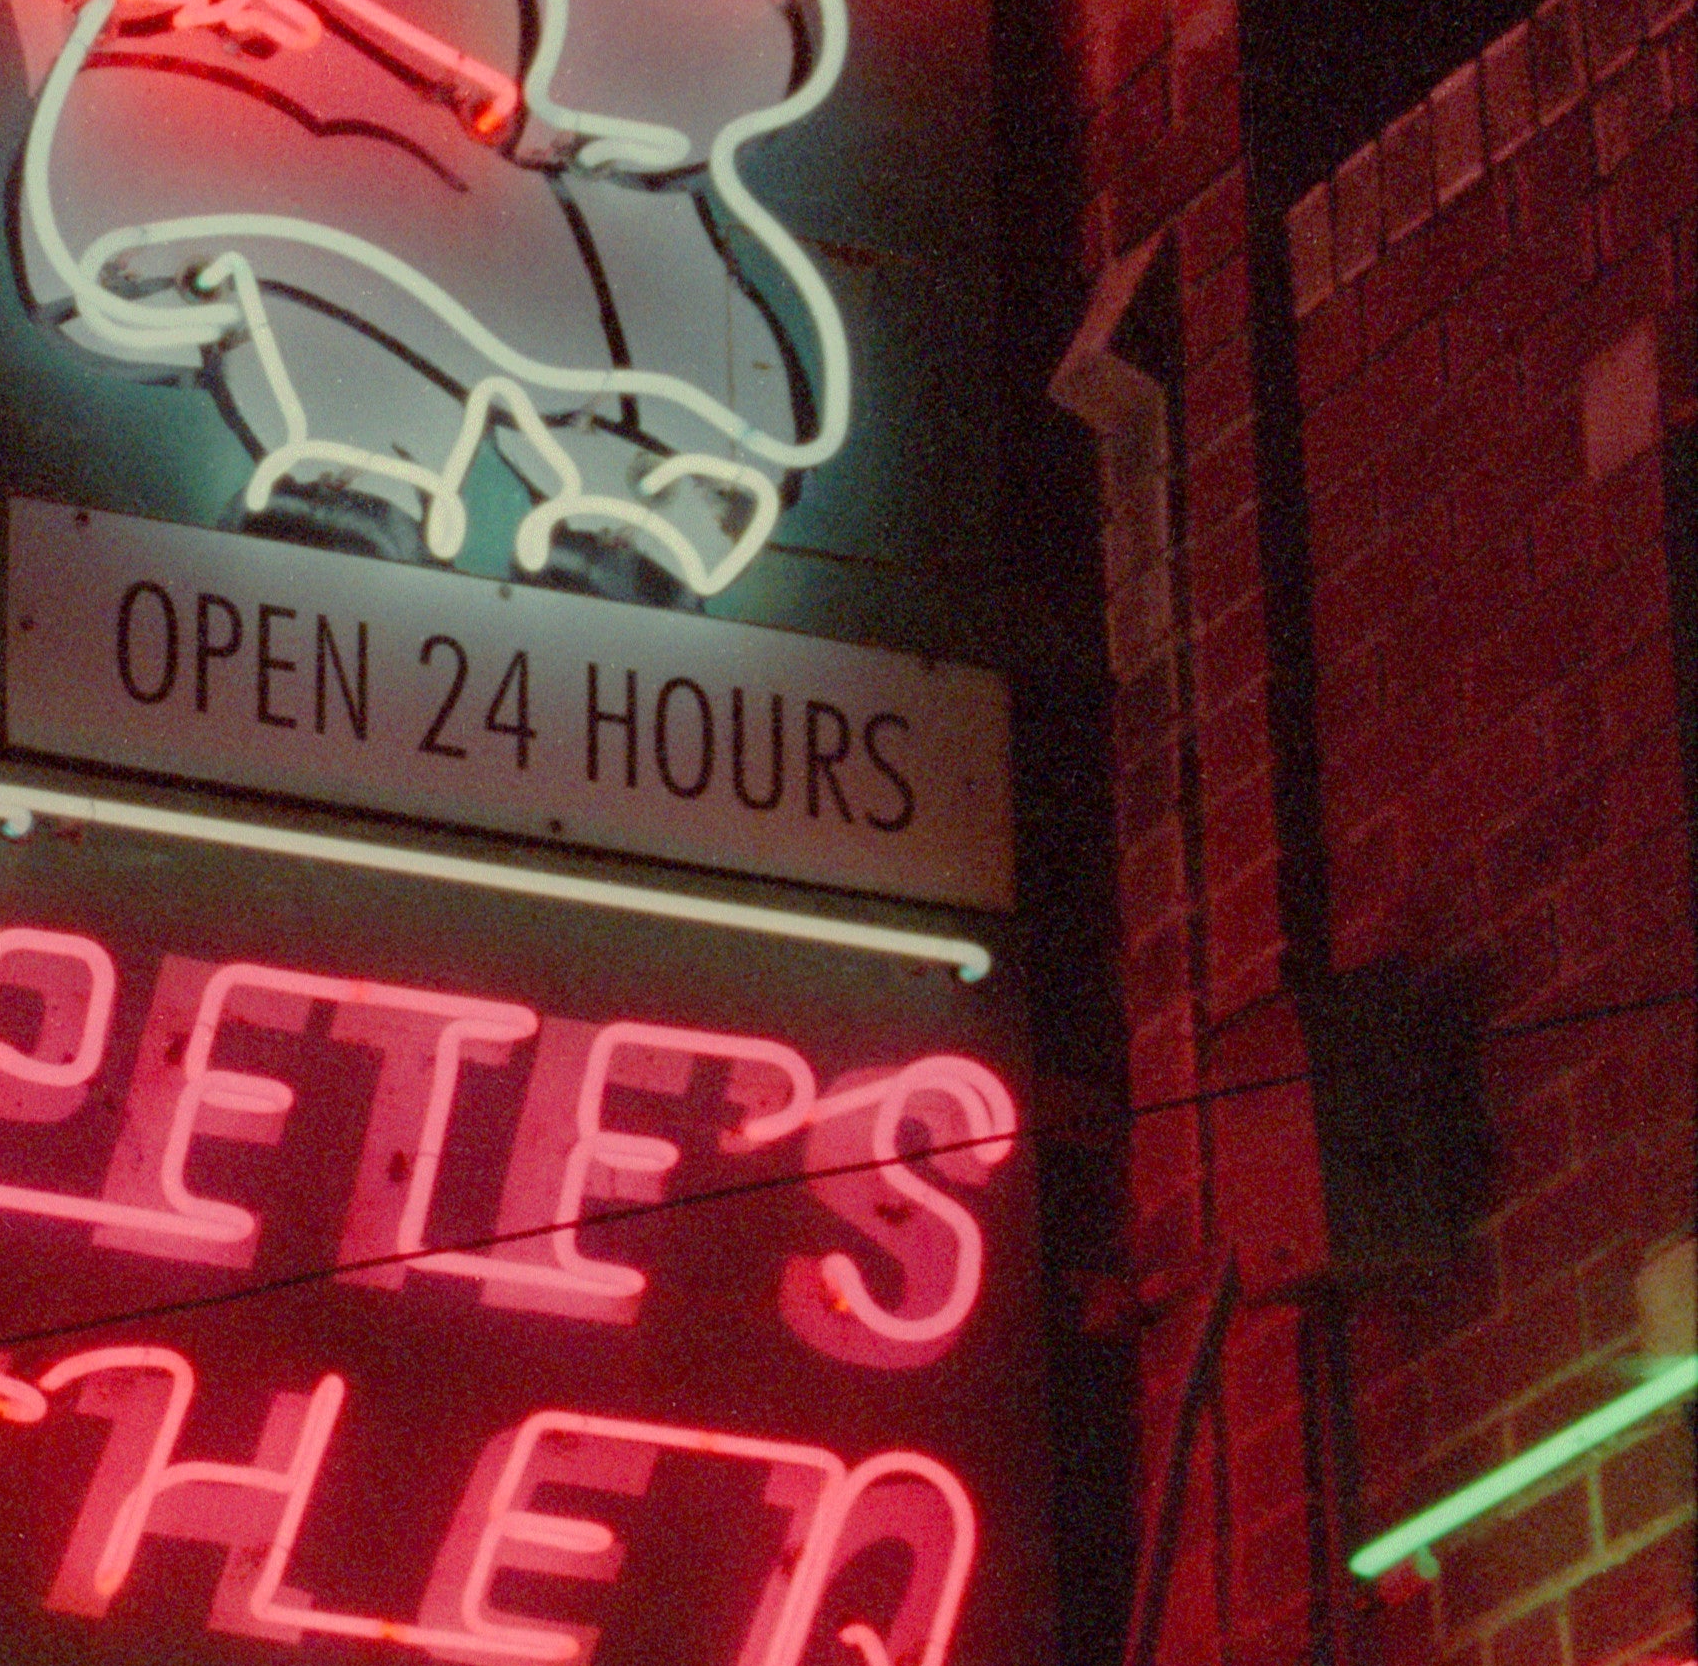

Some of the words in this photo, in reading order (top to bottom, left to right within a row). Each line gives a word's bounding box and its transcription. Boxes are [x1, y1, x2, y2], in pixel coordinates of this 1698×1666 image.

[115, 581, 370, 741] OPEN
[417, 634, 538, 770] 24
[586, 661, 916, 833] HOURS
